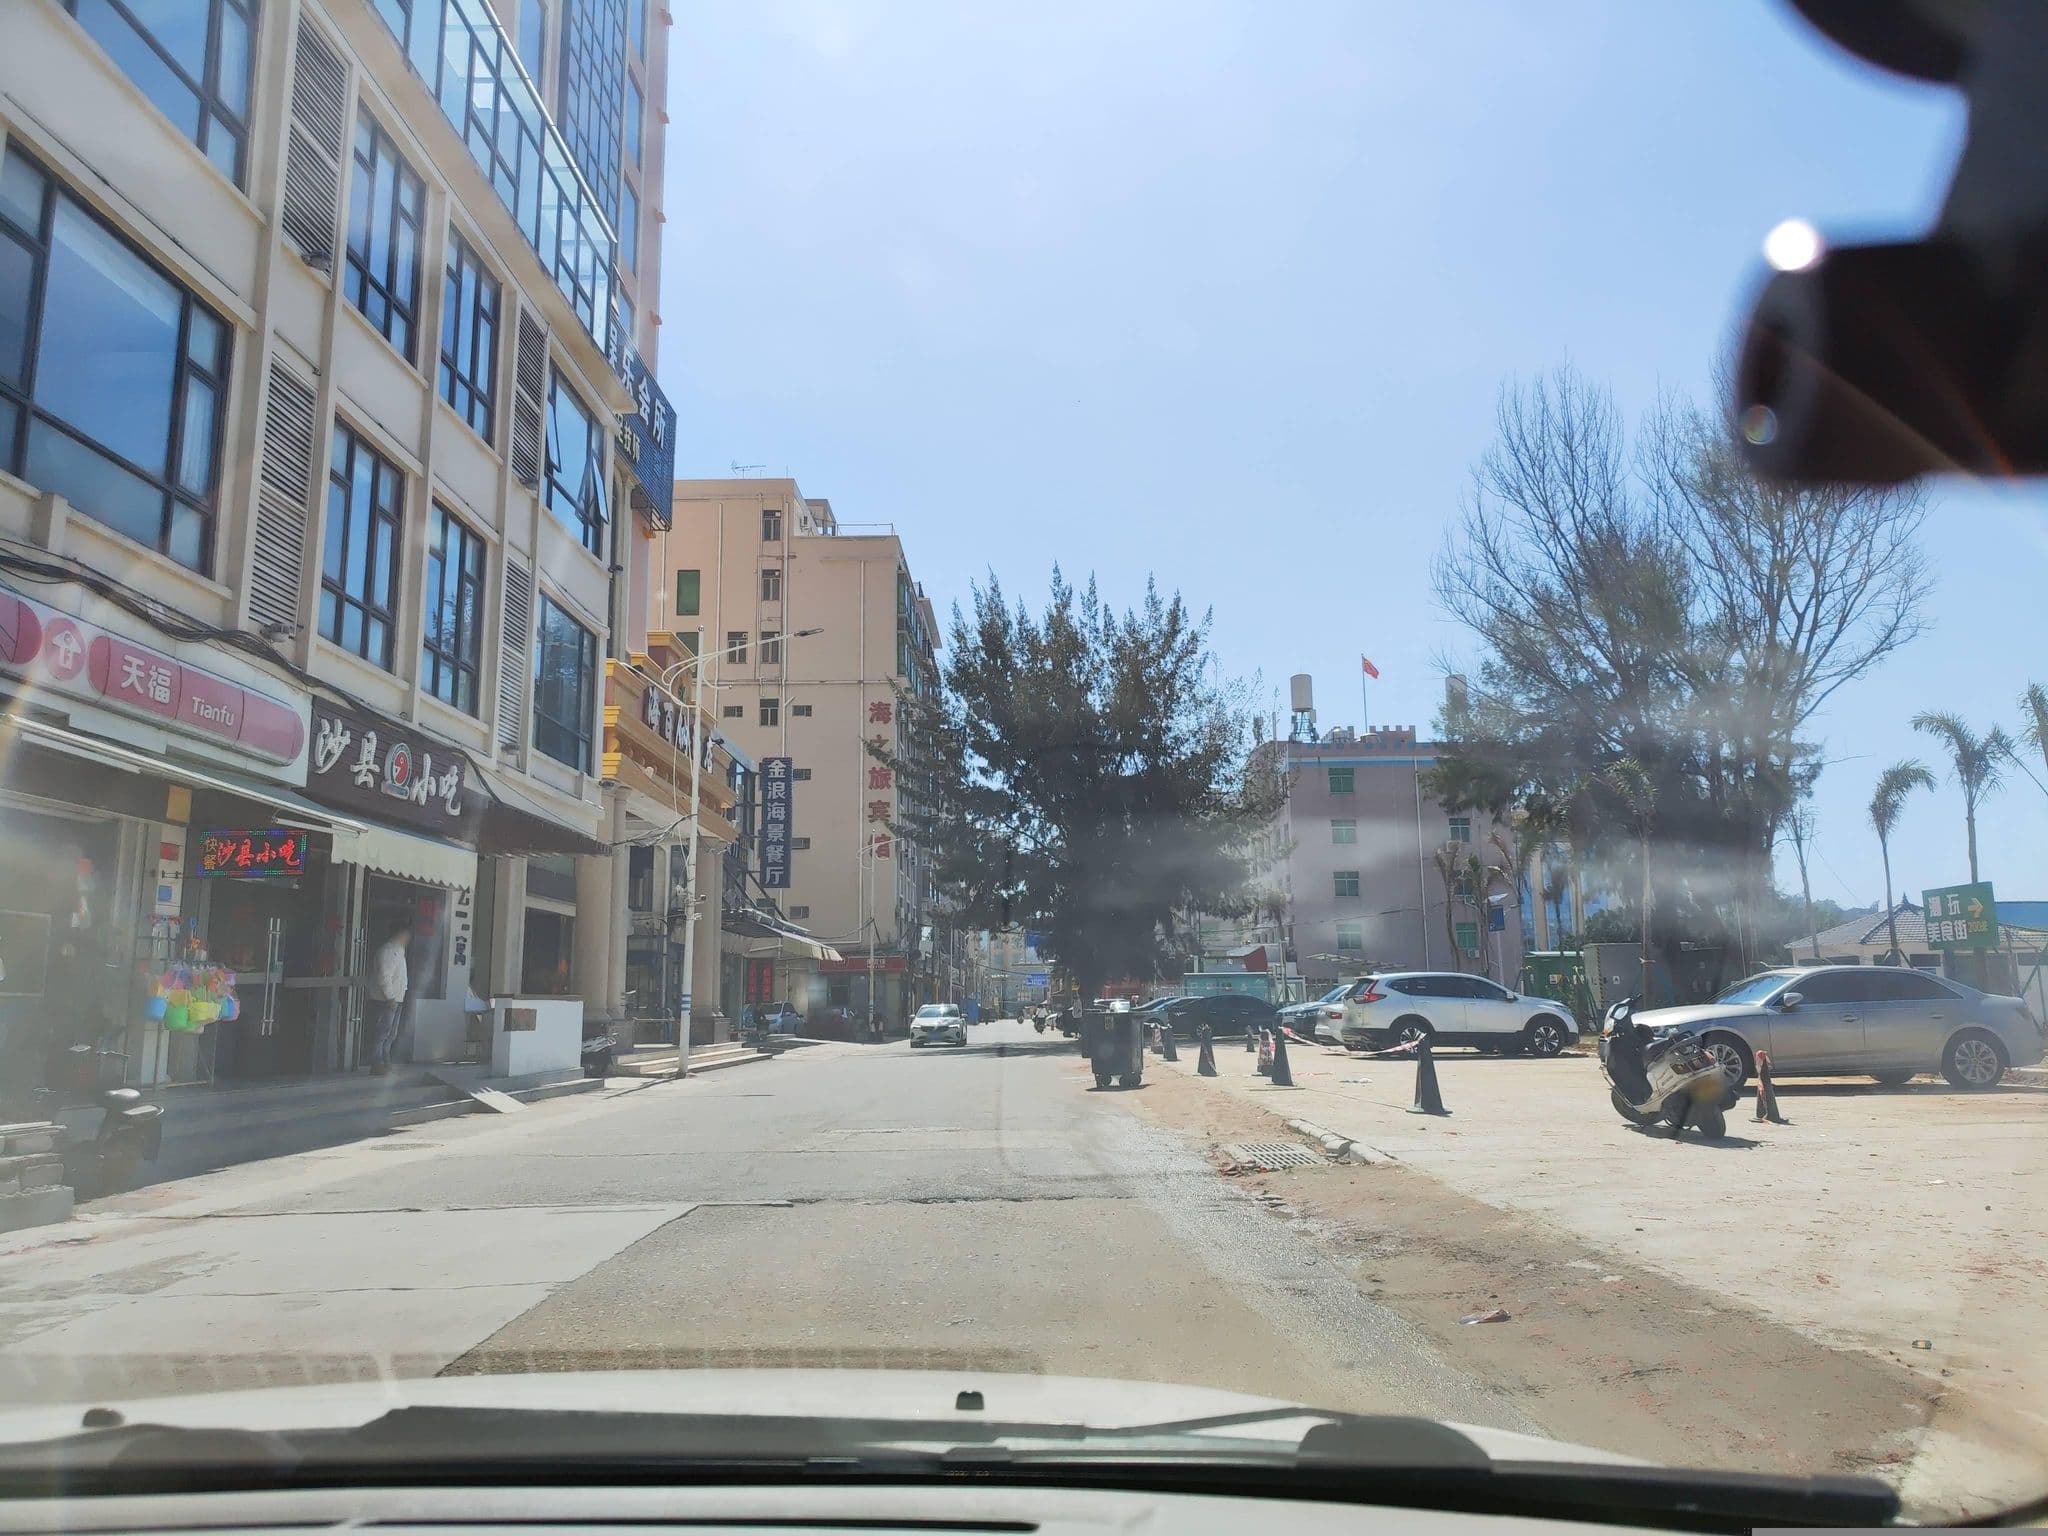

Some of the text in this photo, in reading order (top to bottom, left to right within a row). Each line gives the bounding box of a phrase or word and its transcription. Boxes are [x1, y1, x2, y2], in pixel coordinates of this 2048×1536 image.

[119, 653, 172, 705] 天福
[192, 696, 234, 726] Tianfu
[314, 717, 463, 817] 沙县小吃
[765, 759, 786, 886] 金浪海景餐厅
[217, 838, 300, 867] 沙县小吃
[1926, 919, 1968, 942] 美食街
